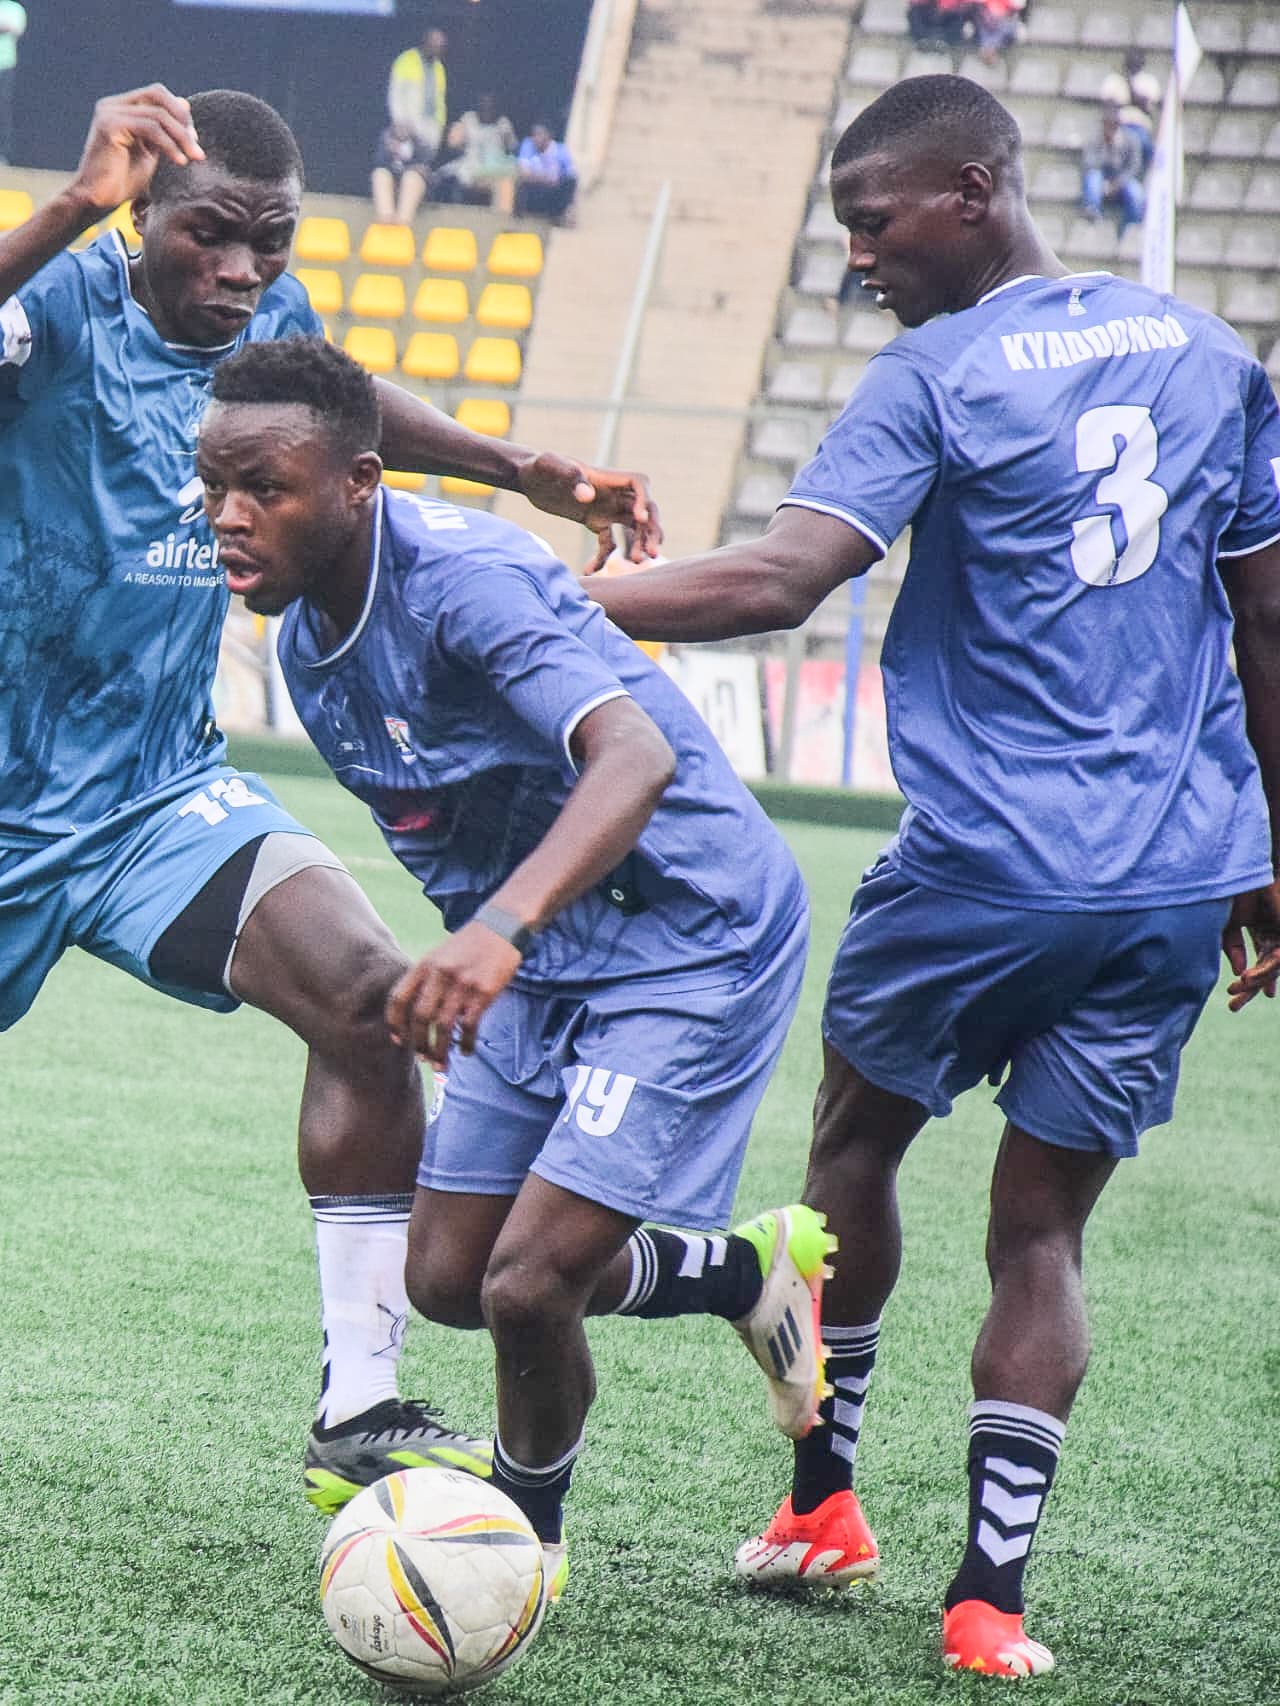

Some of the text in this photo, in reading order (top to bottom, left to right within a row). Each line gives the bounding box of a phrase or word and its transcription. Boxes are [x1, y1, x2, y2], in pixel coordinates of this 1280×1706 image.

[1000, 313, 1190, 371] KYADDONDO
[1070, 404, 1169, 587] 3
[147, 533, 219, 569] airtel
[134, 572, 176, 585] REASON
[178, 575, 191, 586] TO
